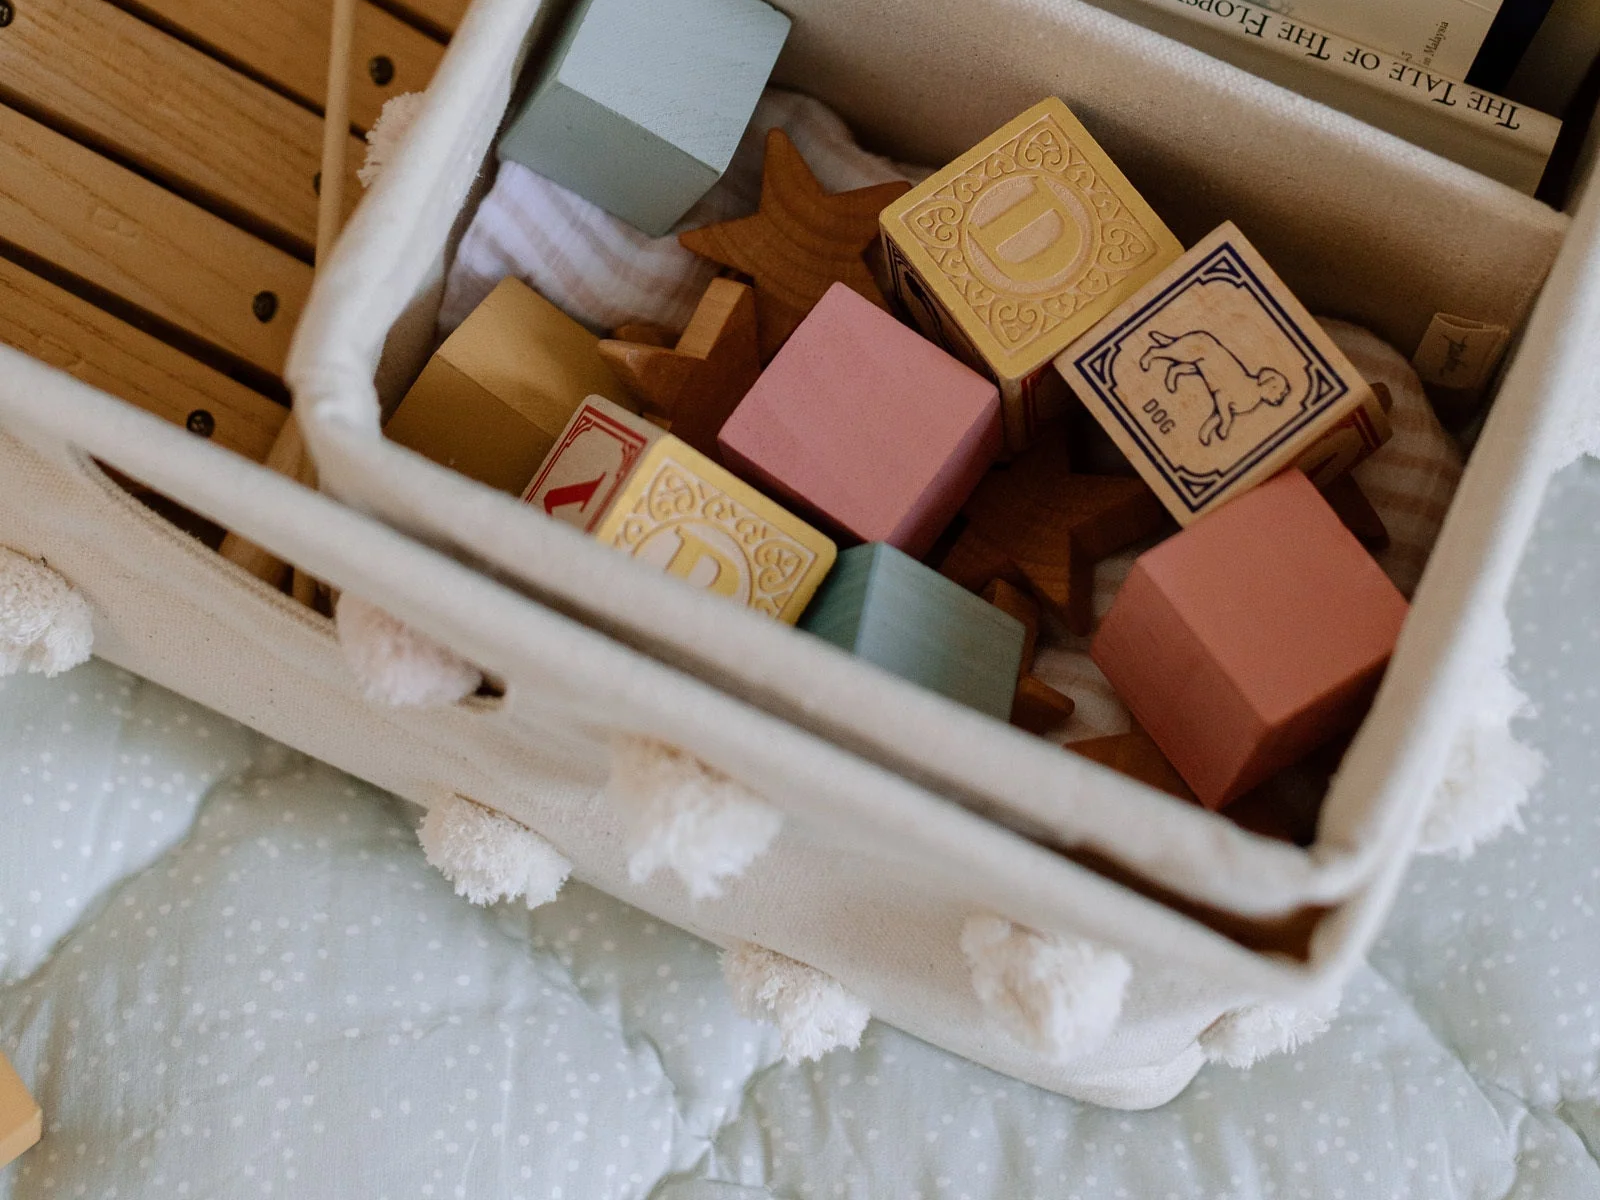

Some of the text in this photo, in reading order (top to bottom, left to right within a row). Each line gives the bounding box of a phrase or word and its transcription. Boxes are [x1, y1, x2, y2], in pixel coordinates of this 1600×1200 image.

[1277, 21, 1331, 61] THE
[1423, 20, 1450, 57] Malaysia
[1342, 47, 1381, 71] OF
[1388, 62, 1457, 106] TALE
[1467, 91, 1520, 130] THE
[967, 175, 1084, 283] D
[1142, 398, 1176, 435] DOG
